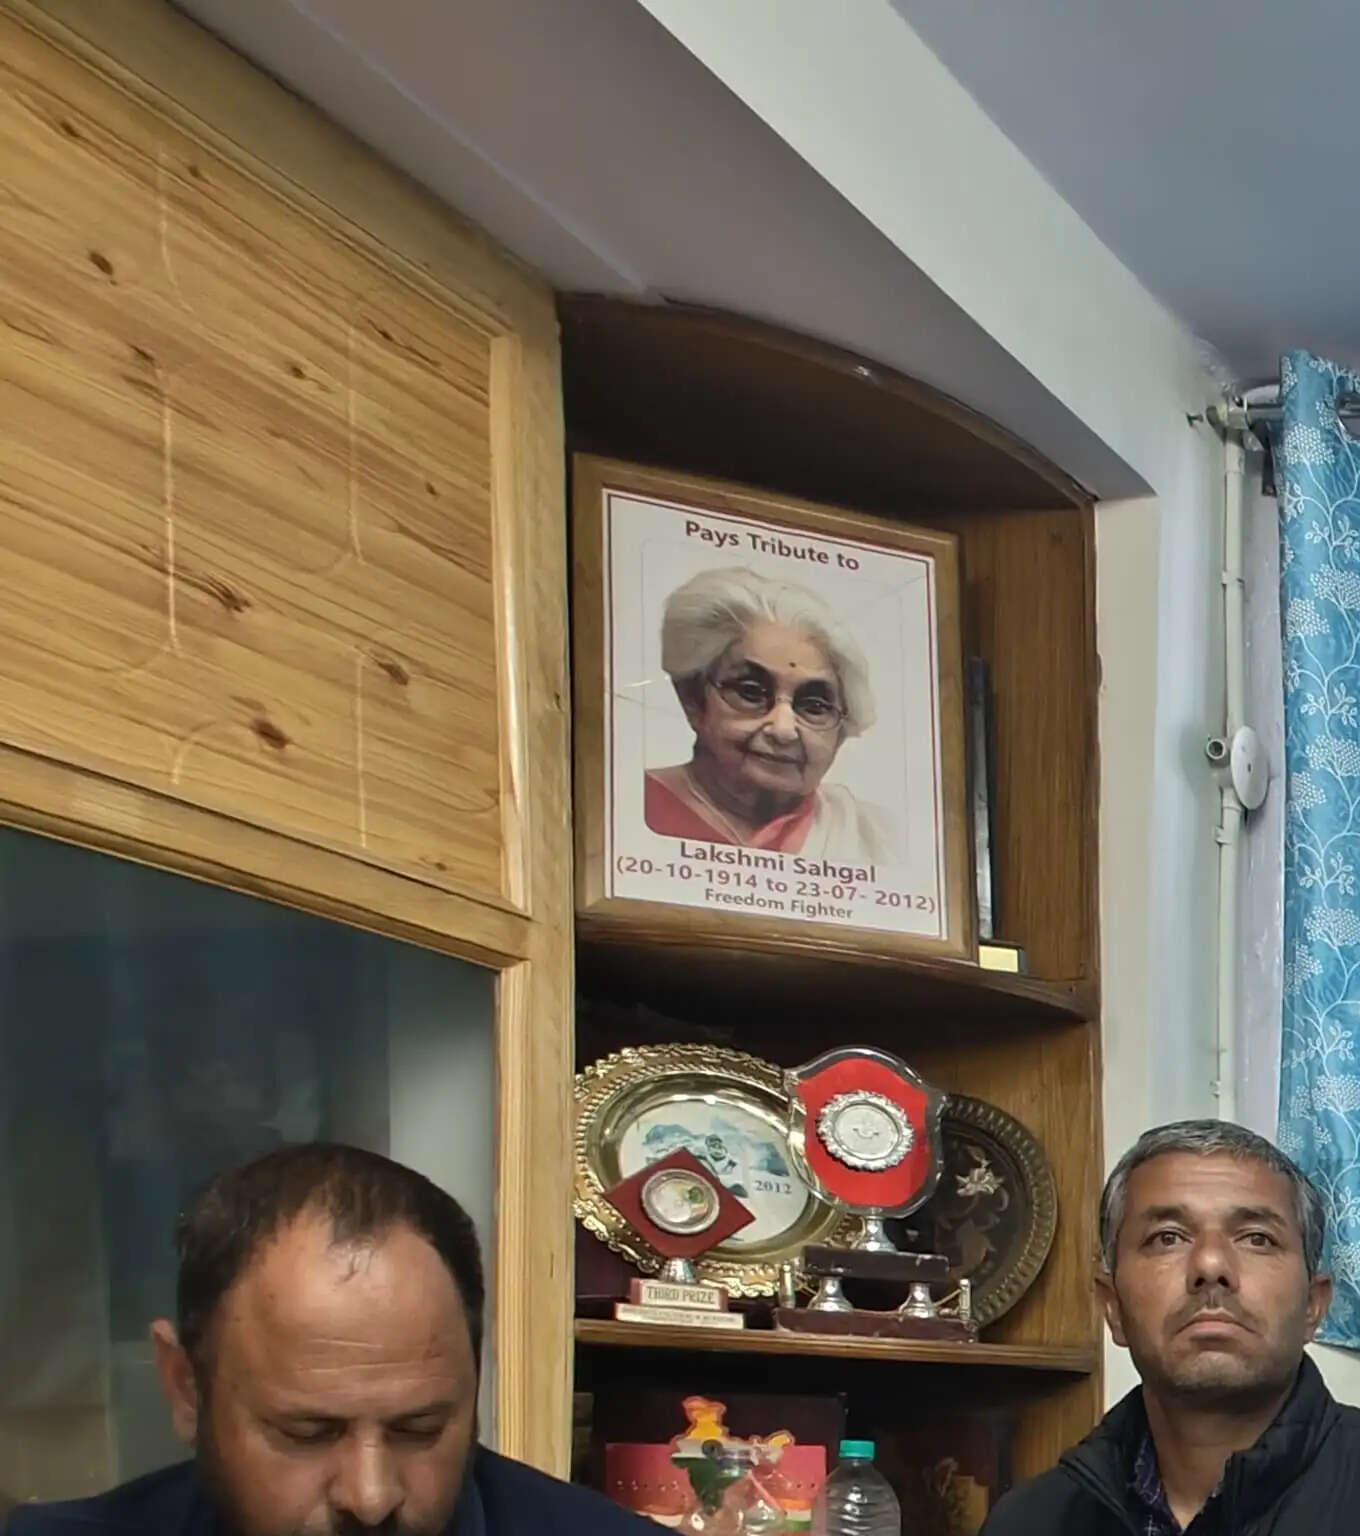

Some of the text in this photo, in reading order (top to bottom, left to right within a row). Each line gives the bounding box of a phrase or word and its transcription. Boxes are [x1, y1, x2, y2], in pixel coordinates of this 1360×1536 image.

[685, 520, 860, 571] Pays Tribute to
[680, 841, 876, 884] Lakshmi Sahgal
[616, 855, 758, 889] (20-10-1914
[766, 877, 788, 894] to
[874, 889, 936, 914] 2012)
[704, 887, 853, 919] Freedom Fighter
[754, 1179, 793, 1195] 2012
[646, 1285, 715, 1305] THIRD PRIZE
